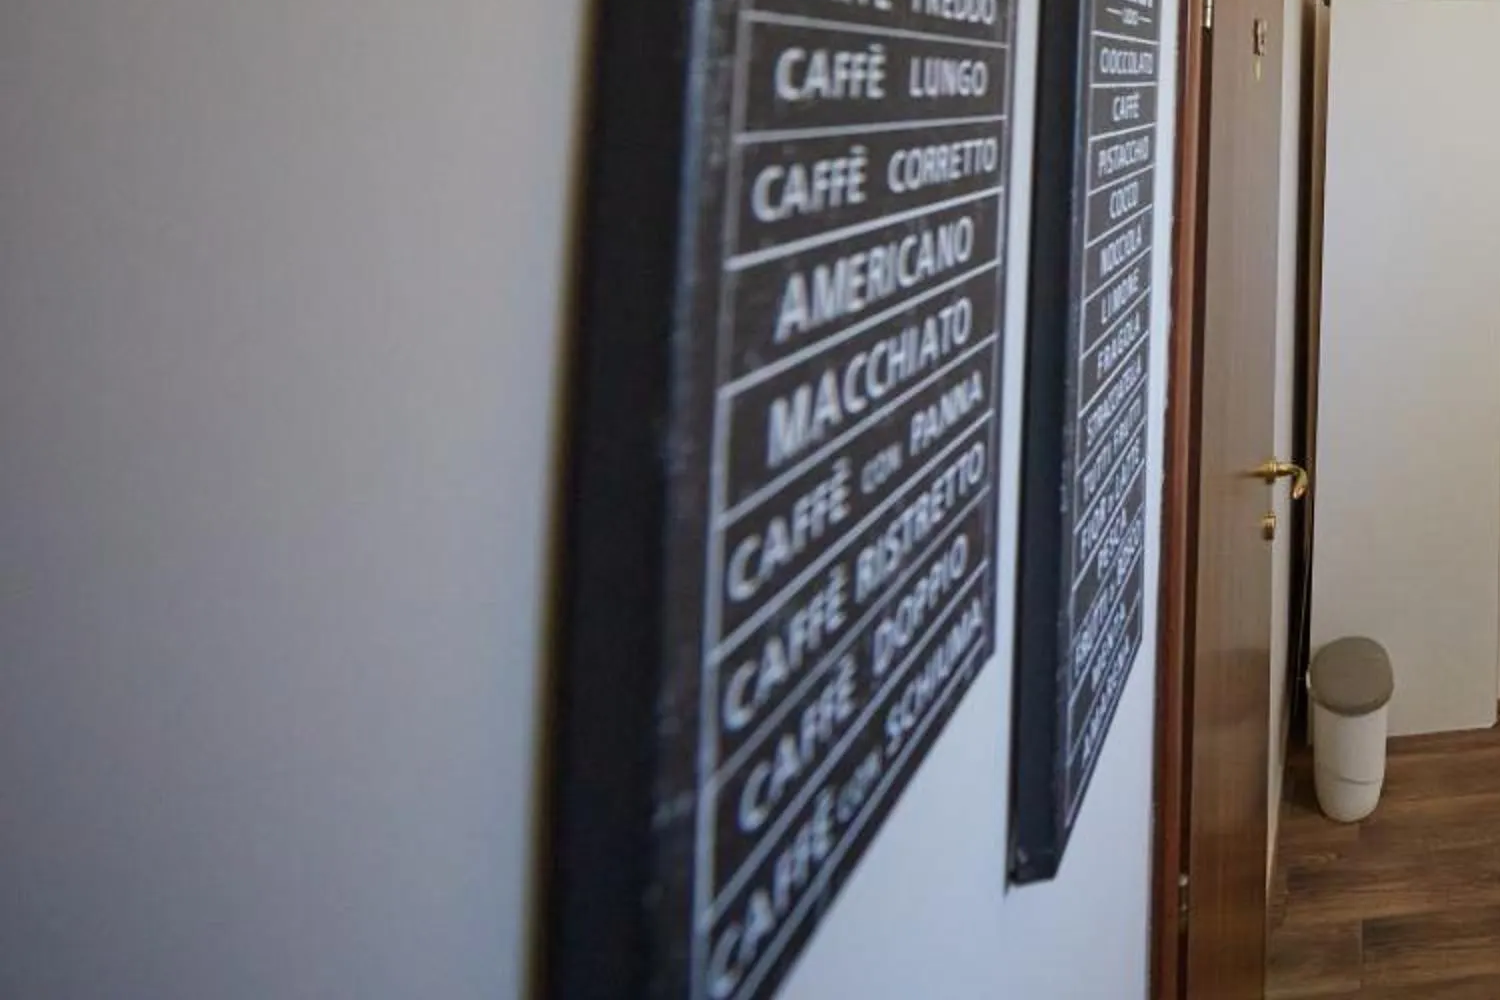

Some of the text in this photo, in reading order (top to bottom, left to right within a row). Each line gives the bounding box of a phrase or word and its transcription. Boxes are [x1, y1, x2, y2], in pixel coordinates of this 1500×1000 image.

[910, 58, 987, 96] LUNGO
[888, 137, 997, 191] CORRETTO
[778, 217, 973, 337] AMERICANO
[770, 298, 971, 461] MACCHIATO
[911, 372, 982, 453] PANNA
[857, 442, 984, 597] RISTRETTO
[874, 535, 967, 673] DOPPIO
